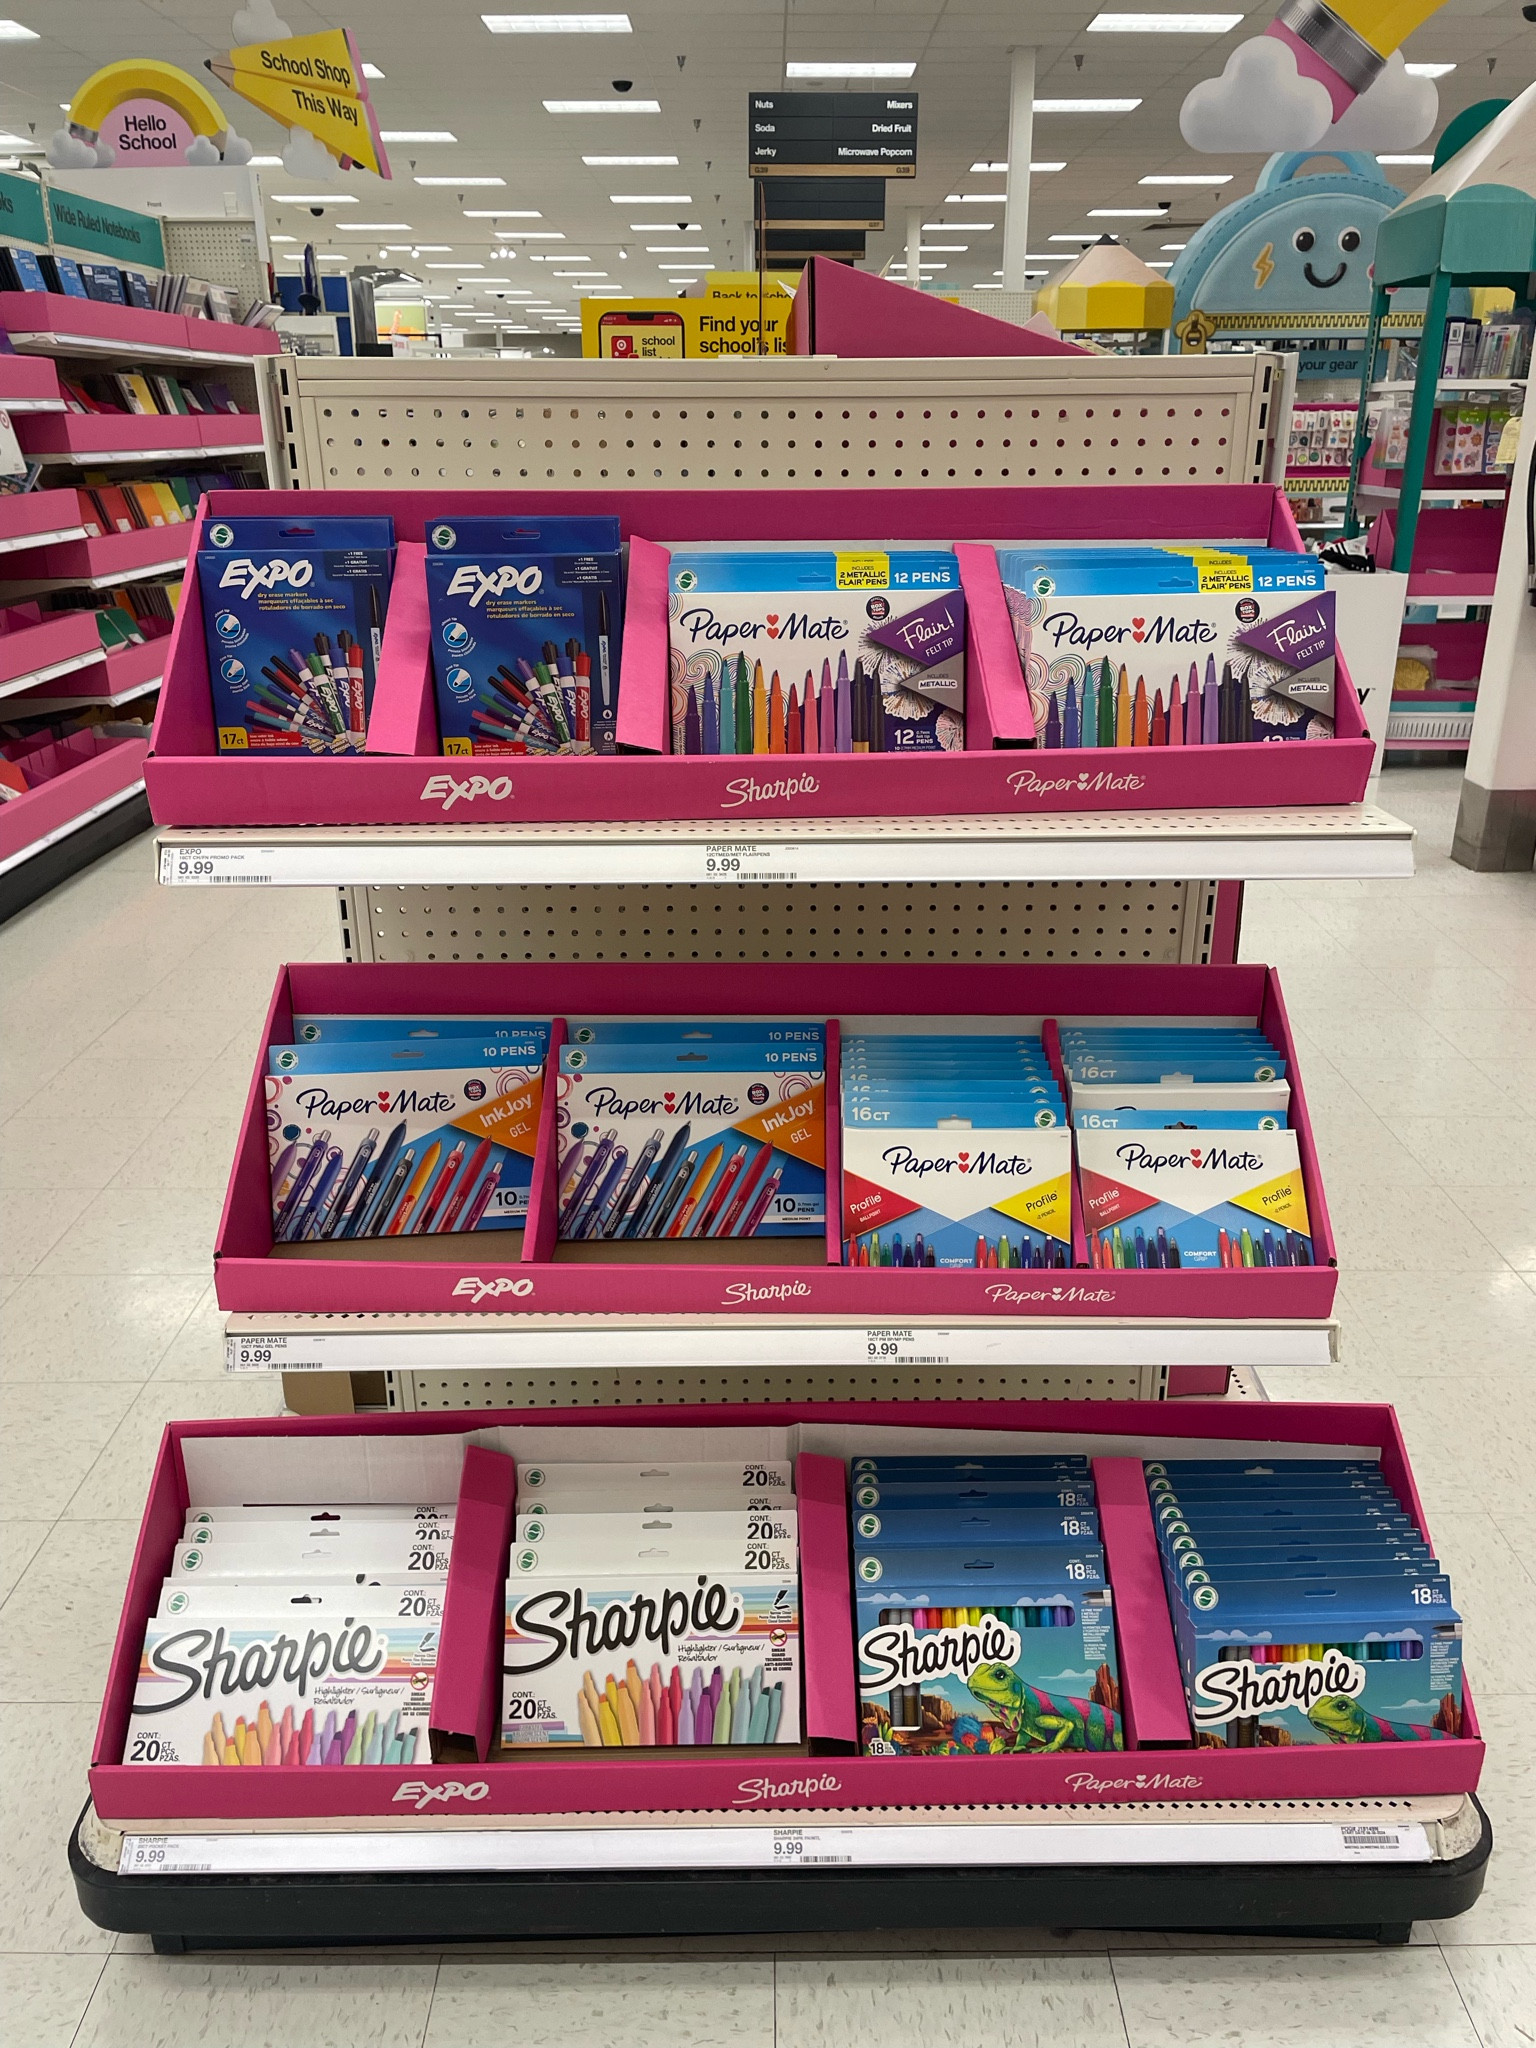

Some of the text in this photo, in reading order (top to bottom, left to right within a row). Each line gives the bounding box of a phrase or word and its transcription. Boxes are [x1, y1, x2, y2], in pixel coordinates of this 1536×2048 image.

[260, 50, 351, 87] School Shop
[292, 90, 358, 126] This Way
[755, 100, 774, 109] Nuts
[886, 100, 913, 109] Mixers
[124, 115, 167, 132] Hello
[755, 124, 776, 133] Soda
[872, 124, 912, 133] Dried Fruit
[119, 134, 177, 151] School
[755, 147, 777, 157] Jerky
[838, 147, 913, 157] Microwave Popcorn
[0, 191, 13, 214] ks
[53, 203, 141, 244] Wide Ruled Notebooks
[700, 316, 778, 335] Find your
[642, 336, 675, 346] school
[774, 338, 786, 353] lis
[642, 347, 656, 356] list
[1299, 361, 1358, 373] your gear
[219, 559, 313, 600] EXPO
[447, 565, 543, 607] EXPO
[894, 572, 951, 583] 12 PENS
[1258, 575, 1317, 587] 12 PENS
[680, 607, 849, 646] Paper Mate
[1042, 611, 1218, 650] Paper Mate
[925, 637, 954, 657] FELT TIP
[1296, 640, 1326, 661] FELT TIP
[351, 679, 363, 709] EXPO
[578, 688, 589, 719] EXPO
[222, 733, 244, 745] 17ct
[894, 729, 914, 745] 12
[446, 743, 469, 755] 17ct
[420, 774, 513, 811] EXPO
[720, 771, 819, 808] Sharpie
[1006, 769, 1145, 798] Paper Mate
[178, 861, 214, 875] 9.99
[706, 858, 741, 872] 9.99
[768, 1031, 820, 1041] 10 PENS
[483, 1045, 537, 1057] 10 PENS
[765, 1052, 817, 1063] 10 PENS
[296, 1087, 456, 1120] Paper Mate
[479, 1093, 534, 1128] InkJoy
[586, 1087, 740, 1120] Paper Mate
[761, 1099, 815, 1133] InkJoy
[509, 1121, 532, 1138] GEL
[790, 1128, 812, 1144] GEL
[882, 1145, 1032, 1178] Paper Mate
[1116, 1142, 1264, 1174] Paper Mate
[495, 1191, 517, 1206] 10
[850, 1192, 882, 1214] Profile
[1025, 1192, 1058, 1212] Profile
[1089, 1187, 1120, 1209] Profile
[1261, 1186, 1292, 1206] Profile
[774, 1198, 796, 1213] 10
[1099, 1203, 1121, 1217] BALLPOINT
[860, 1209, 881, 1223] BALLPOINT
[451, 1277, 534, 1304] EXPO
[721, 1279, 811, 1305] Sharpie
[985, 1282, 1115, 1305] Paper Mate
[240, 1350, 272, 1362] 9.99
[867, 1343, 898, 1355] 9.99
[742, 1470, 768, 1486] 20
[1057, 1492, 1076, 1507] 18
[747, 1522, 773, 1539] 20
[1060, 1520, 1080, 1536] 18
[407, 1551, 435, 1570] 20
[744, 1550, 771, 1570] 20
[1065, 1563, 1086, 1580] 18
[1410, 1588, 1432, 1605] 18
[398, 1597, 427, 1616] 20
[503, 1575, 739, 1675] Sharpie
[677, 1644, 718, 1655] Highlighter
[859, 1621, 1014, 1688] Sharpie
[132, 1617, 382, 1715] Sharpie
[314, 1686, 355, 1698] Highlighter
[1195, 1656, 1358, 1720] Sharpie
[508, 1698, 537, 1719] 20
[130, 1740, 160, 1761] 20
[870, 1742, 884, 1754] 18
[732, 1773, 842, 1804] Sharpie
[1064, 1772, 1202, 1793] Paper Mate
[391, 1781, 490, 1809] EXPO
[135, 1850, 165, 1862] 9.99
[773, 1842, 803, 1855] 9.99
